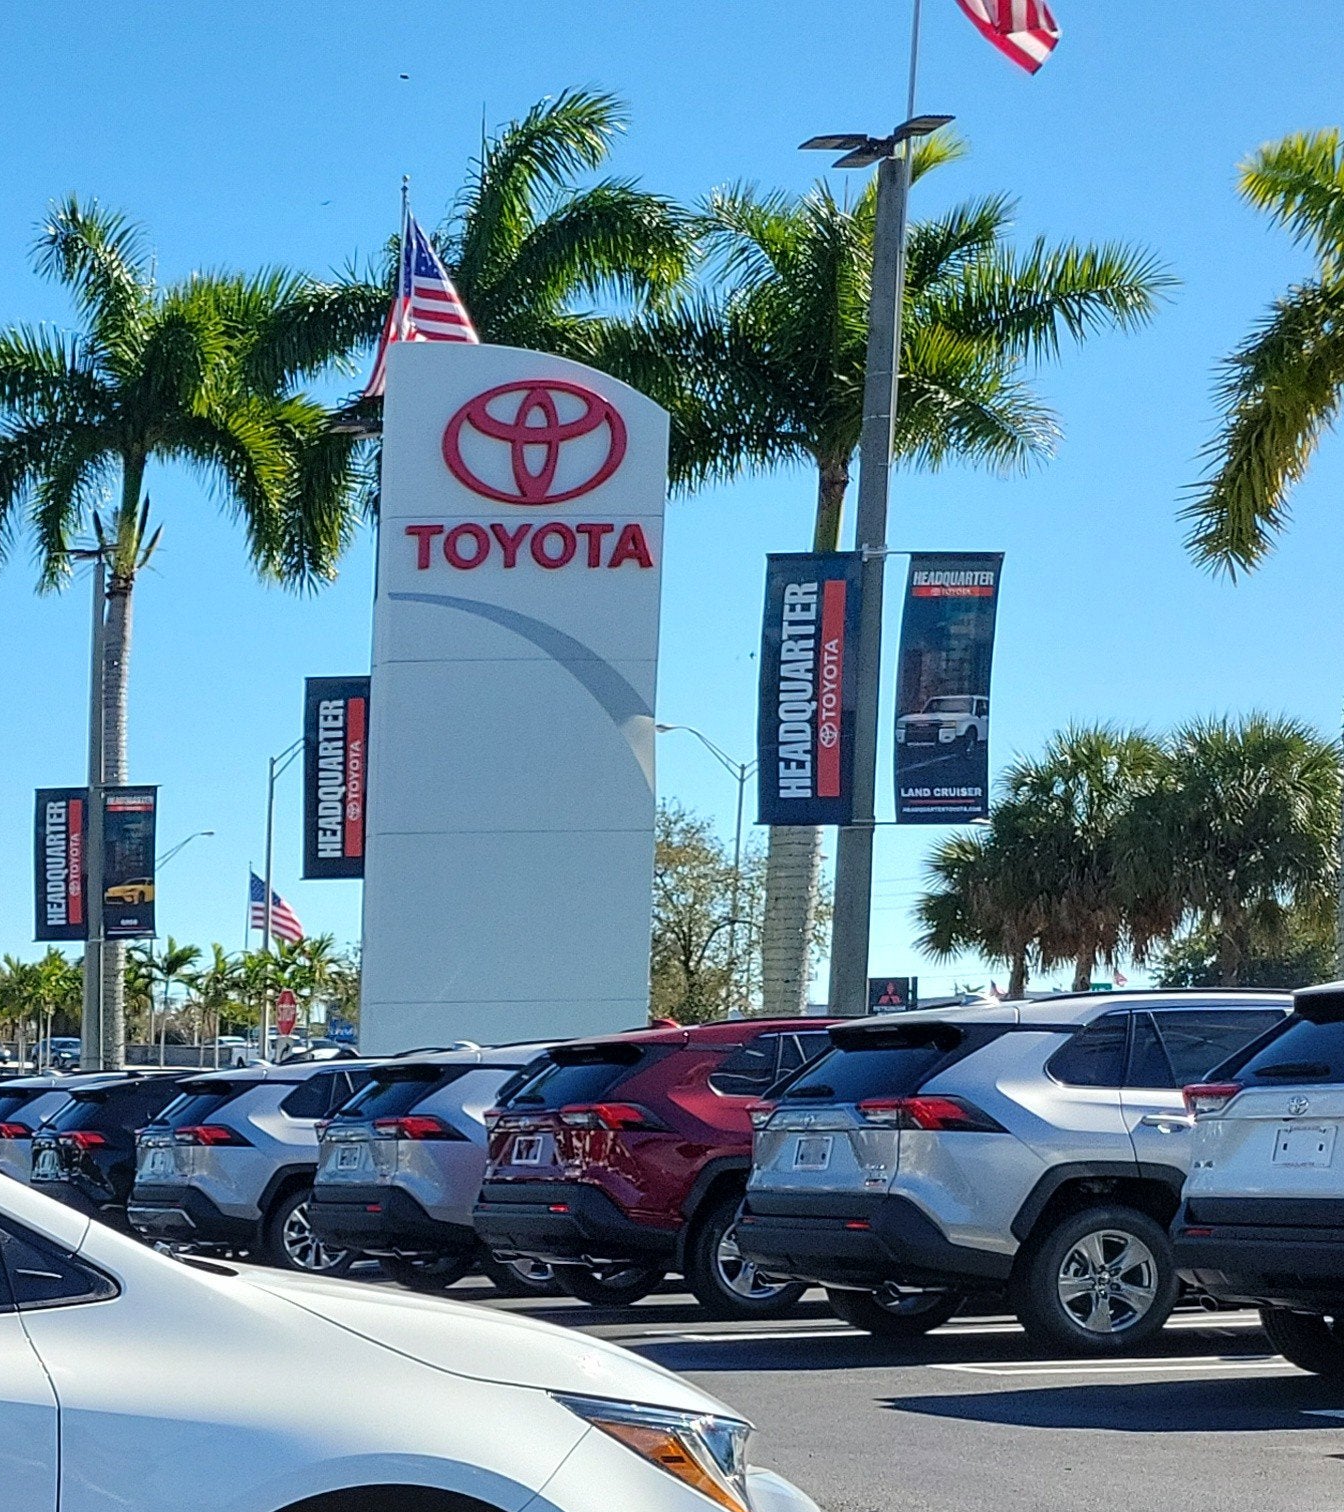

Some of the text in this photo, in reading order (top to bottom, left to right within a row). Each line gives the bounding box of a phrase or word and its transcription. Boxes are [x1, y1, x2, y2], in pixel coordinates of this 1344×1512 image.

[405, 522, 653, 570] TOYOTA
[913, 571, 994, 587] HEADQUARTER
[778, 582, 818, 798] HEADQUARTER
[822, 639, 839, 720] TOYOTA
[318, 699, 346, 858] HEADQUARTER
[349, 741, 362, 799] TOYOTA
[901, 788, 982, 797] LAND CRUISER
[46, 801, 68, 925] HEADQUARTER
